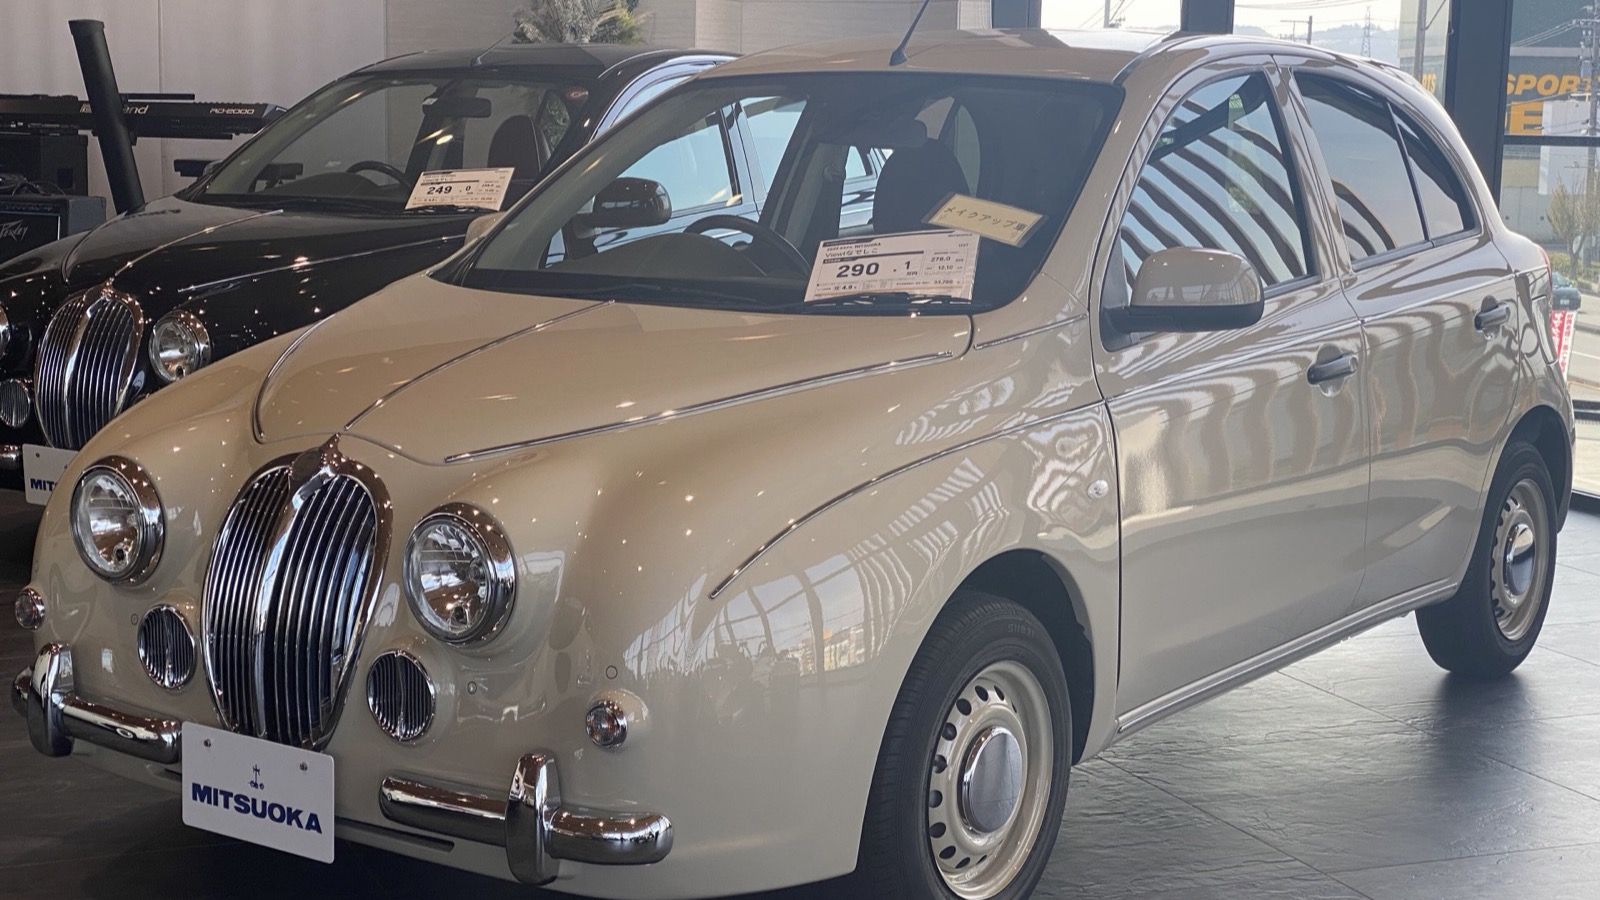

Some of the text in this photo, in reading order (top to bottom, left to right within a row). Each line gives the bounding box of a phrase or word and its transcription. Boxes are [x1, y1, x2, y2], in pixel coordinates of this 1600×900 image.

[427, 185, 453, 195] 249
[836, 262, 880, 279] 290
[30, 478, 57, 492] MIT
[191, 782, 323, 834] MITSUOKA
